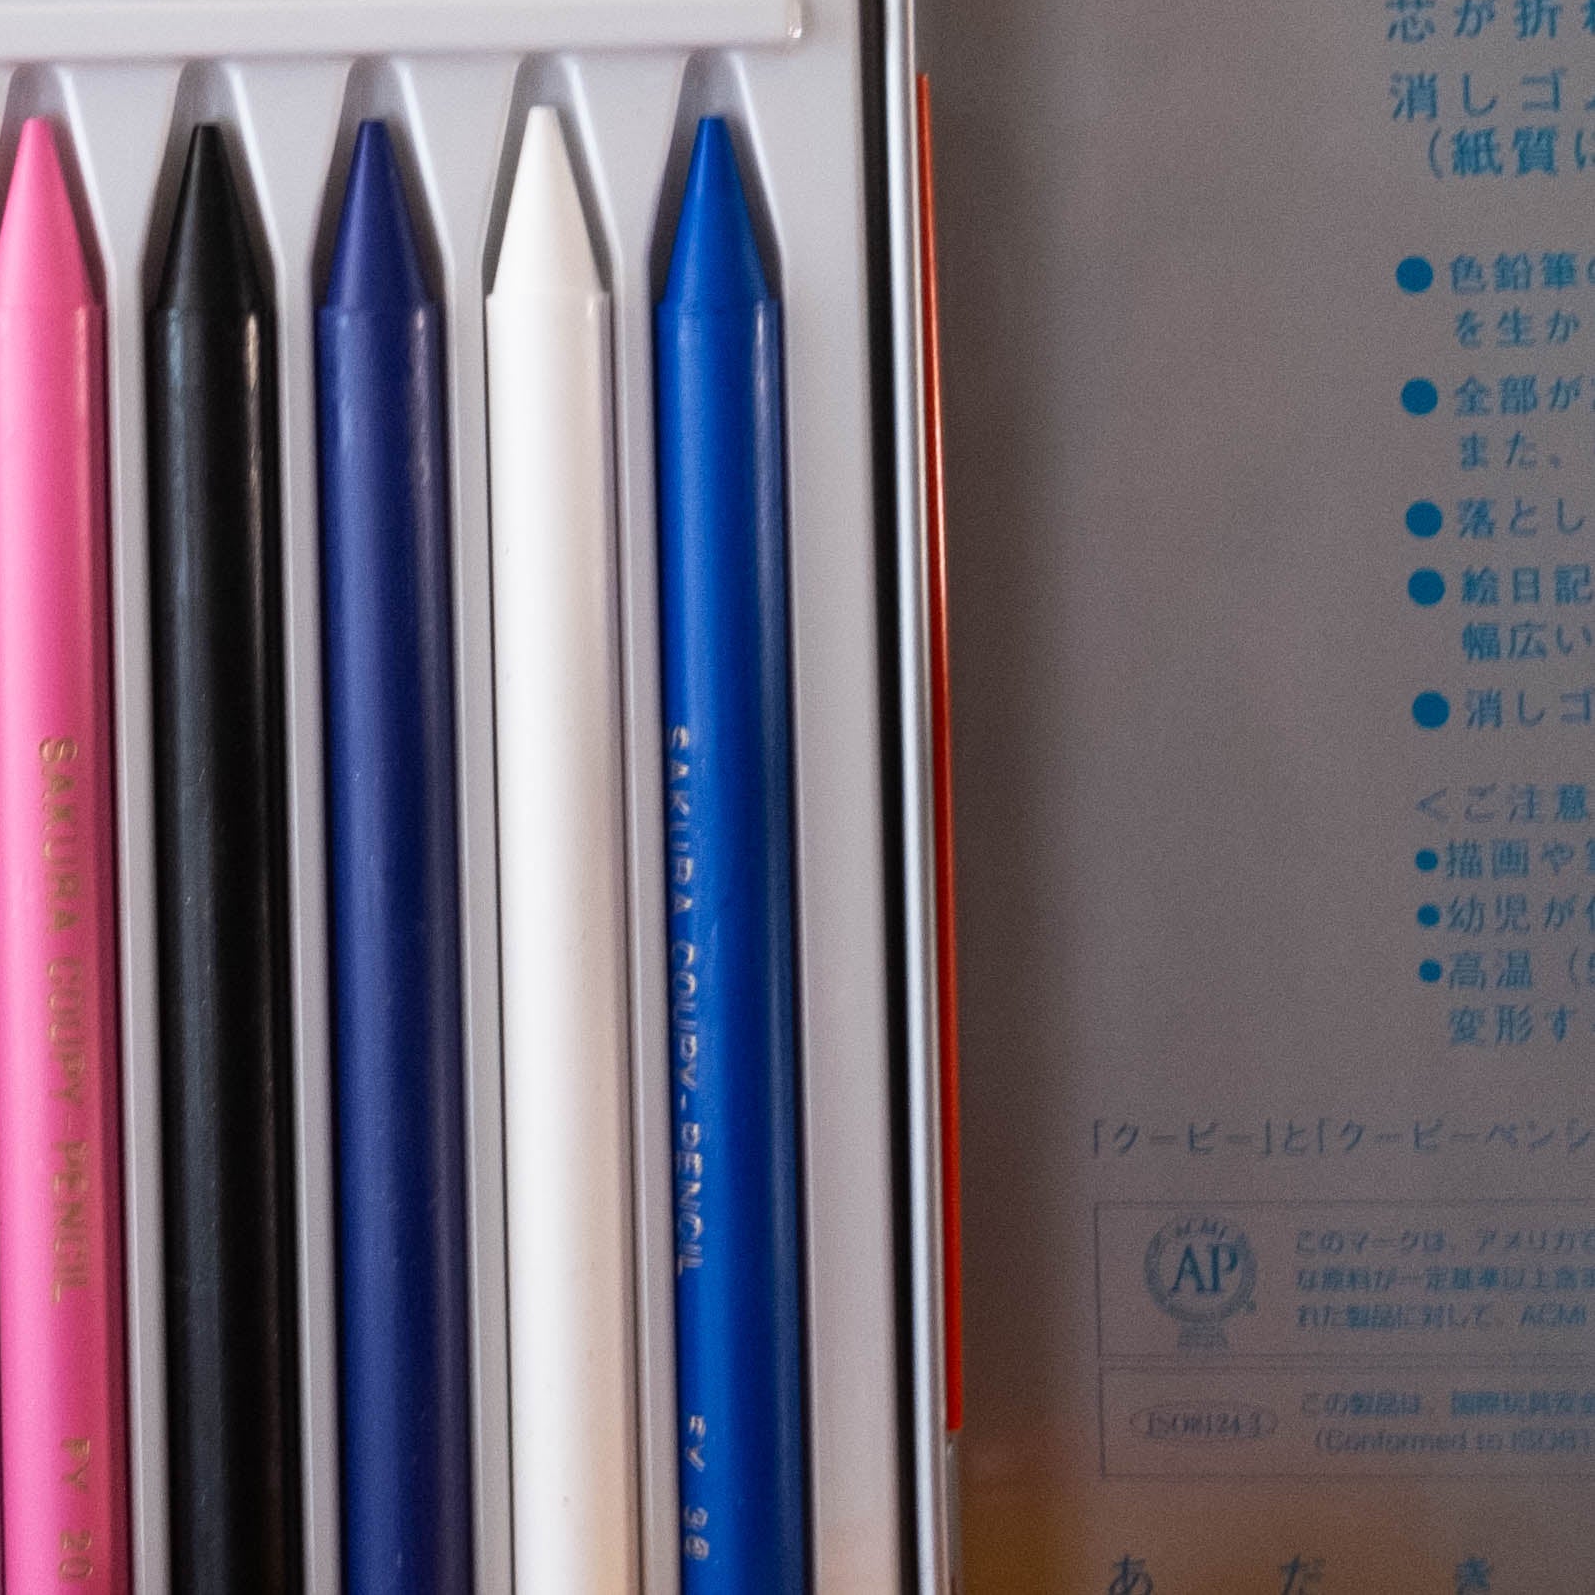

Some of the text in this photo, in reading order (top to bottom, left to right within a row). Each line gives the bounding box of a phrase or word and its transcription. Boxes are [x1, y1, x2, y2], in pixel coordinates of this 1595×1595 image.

[1389, 67, 1595, 122] 消しゴ
[1449, 251, 1595, 295] 色鉛筆
[1453, 373, 1595, 416] 全部が
[1445, 836, 1595, 880] 描画や
[1447, 894, 1595, 937] 幼児が
[1449, 1004, 1595, 1047] 変形す
[38, 736, 94, 1582] SAKURA COUPY-PENCIL FY 20
[1170, 1242, 1240, 1295] AP
